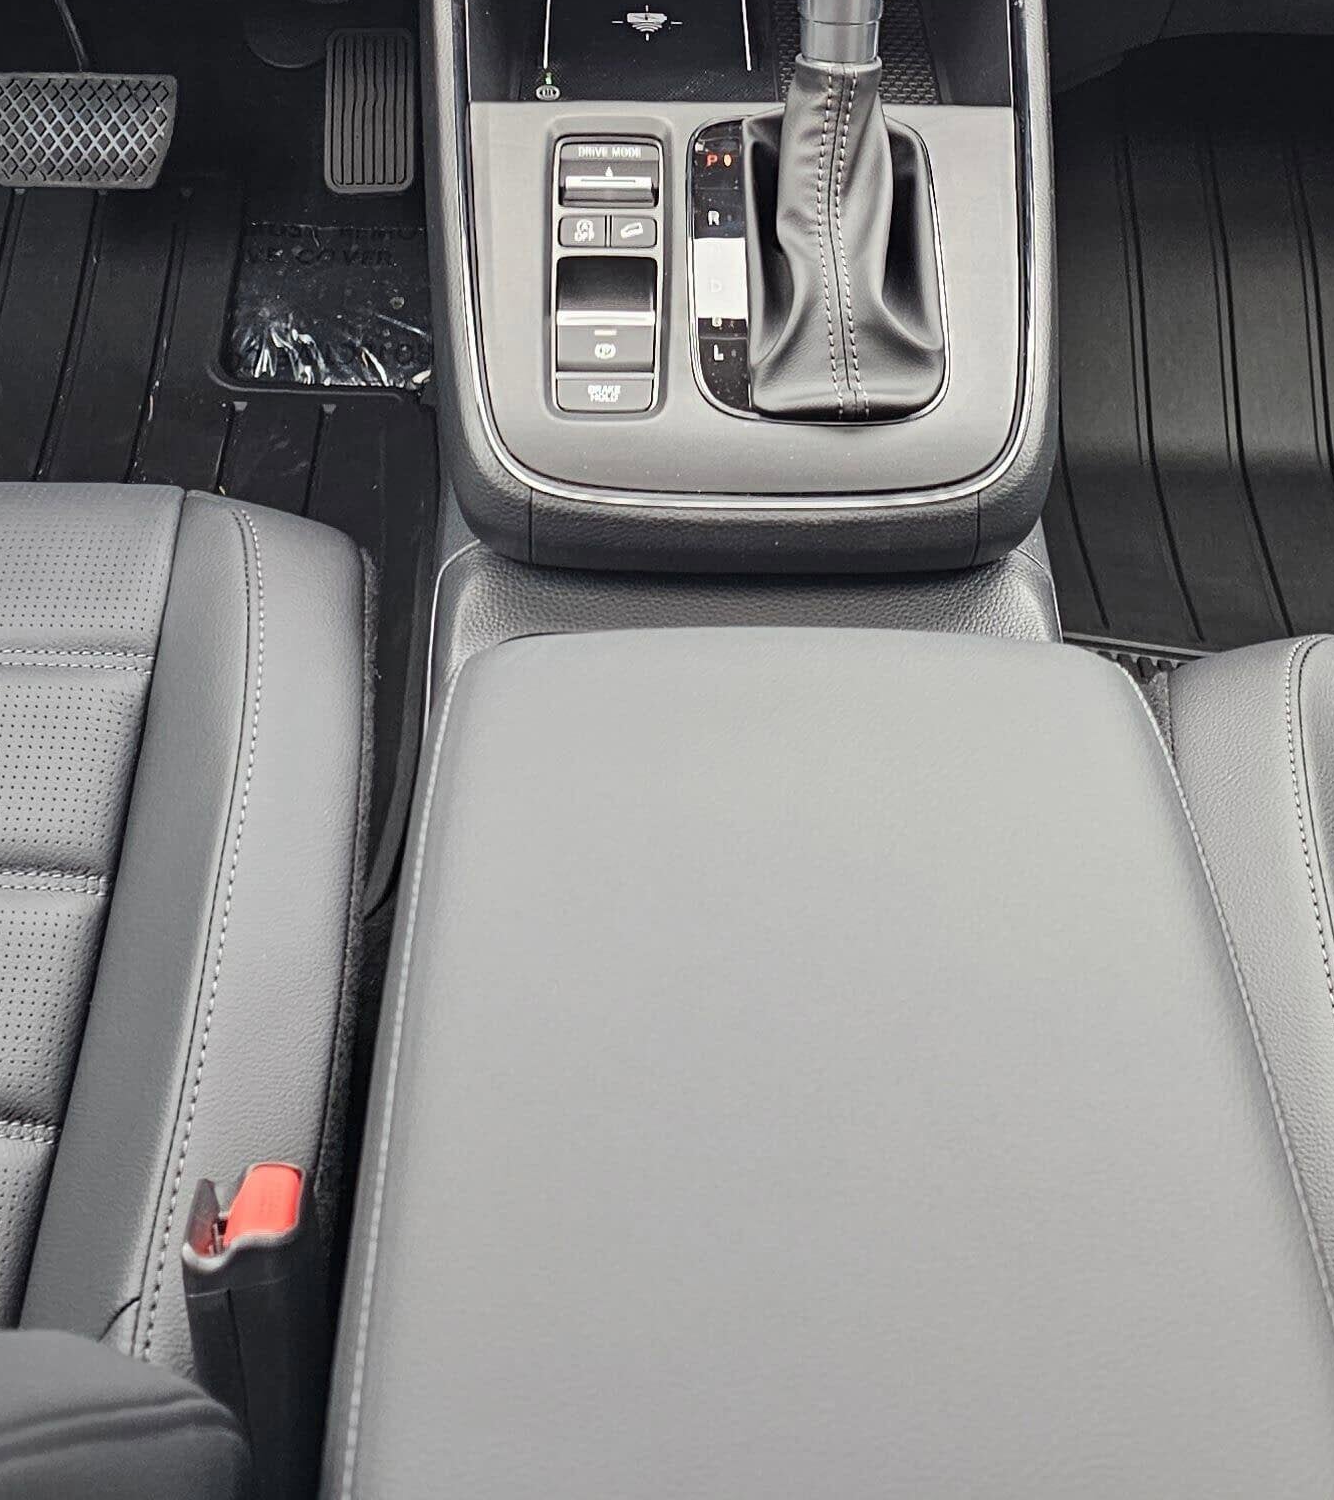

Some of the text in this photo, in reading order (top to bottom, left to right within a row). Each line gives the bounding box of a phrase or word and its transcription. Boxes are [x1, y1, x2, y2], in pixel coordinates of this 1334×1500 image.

[578, 147, 642, 158] DRIVE MODE
[706, 154, 717, 168] P
[708, 210, 719, 226] R
[713, 344, 724, 361] L
[588, 385, 621, 394] BRAKE
